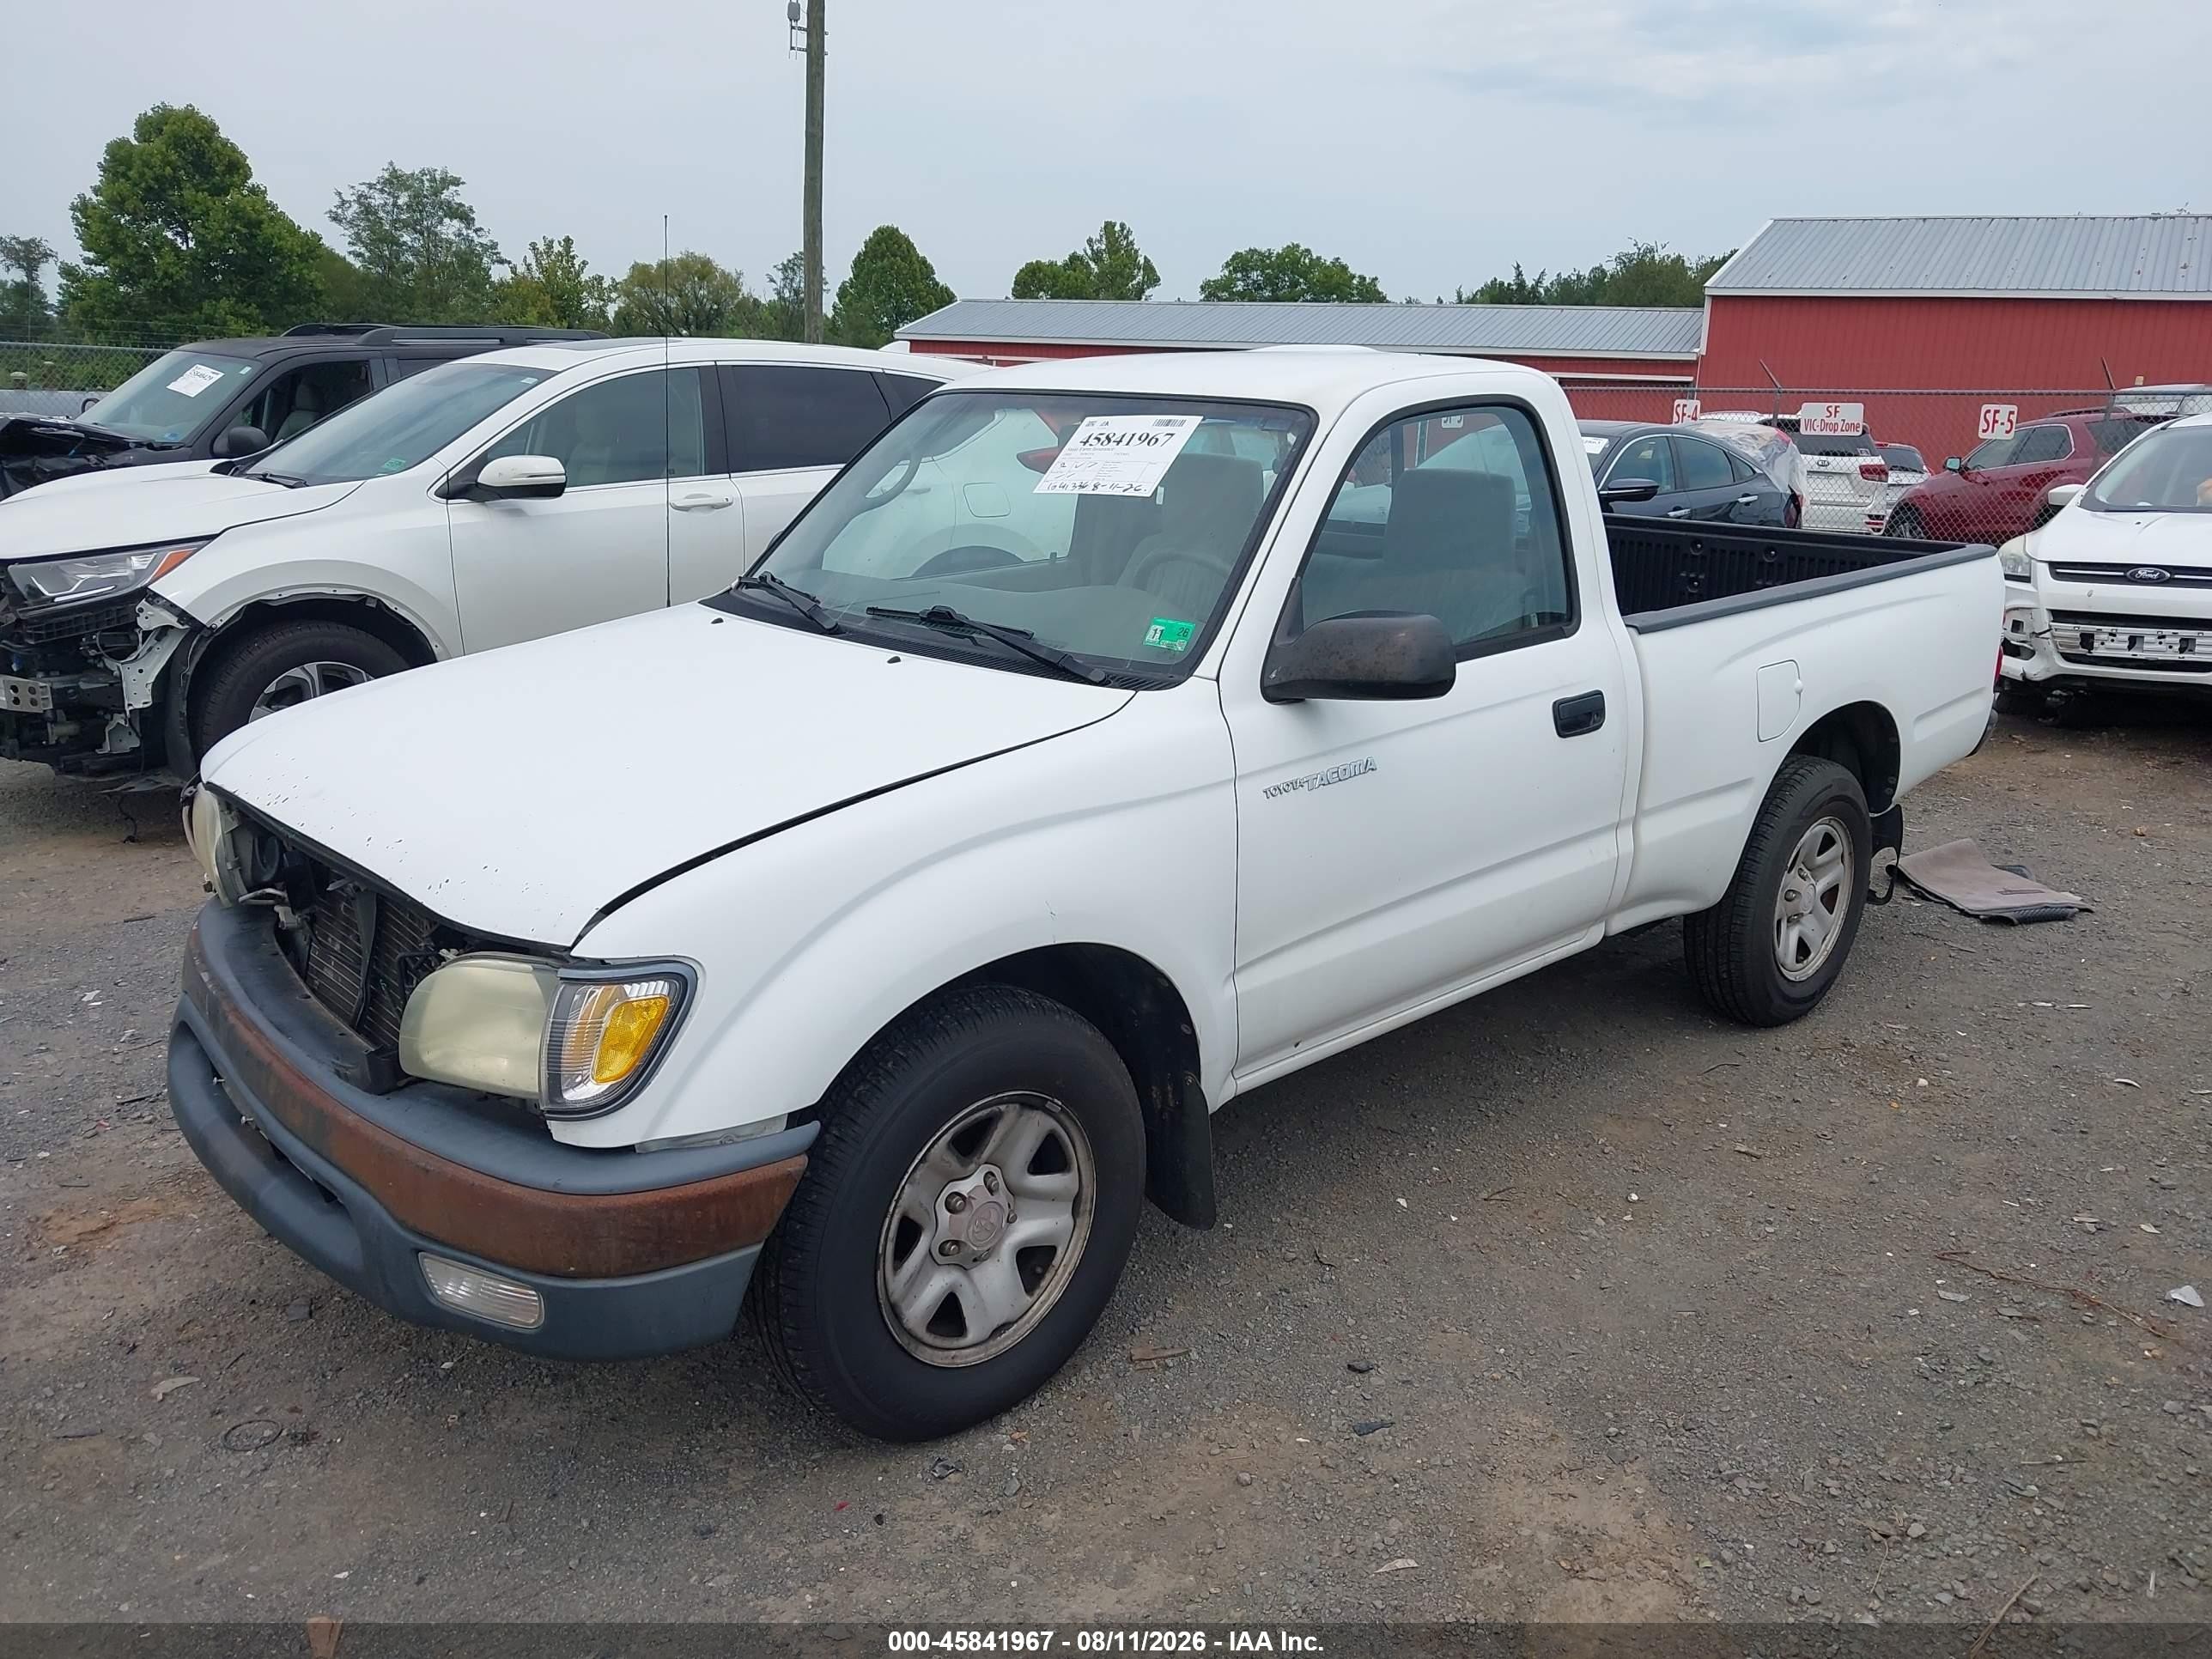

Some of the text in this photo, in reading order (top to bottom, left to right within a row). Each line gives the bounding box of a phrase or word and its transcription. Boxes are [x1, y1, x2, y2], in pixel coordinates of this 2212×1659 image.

[1674, 404, 1698, 423] SF-4
[1826, 405, 1840, 418] SF
[1804, 418, 1861, 433] VIC-Drop Zone
[1982, 409, 2014, 434] SF-5
[1079, 432, 1176, 447] 45841967
[2135, 569, 2160, 579] Ford
[1152, 627, 1190, 640] 11 26
[1263, 757, 1377, 799] TOYOTA TACOMA
